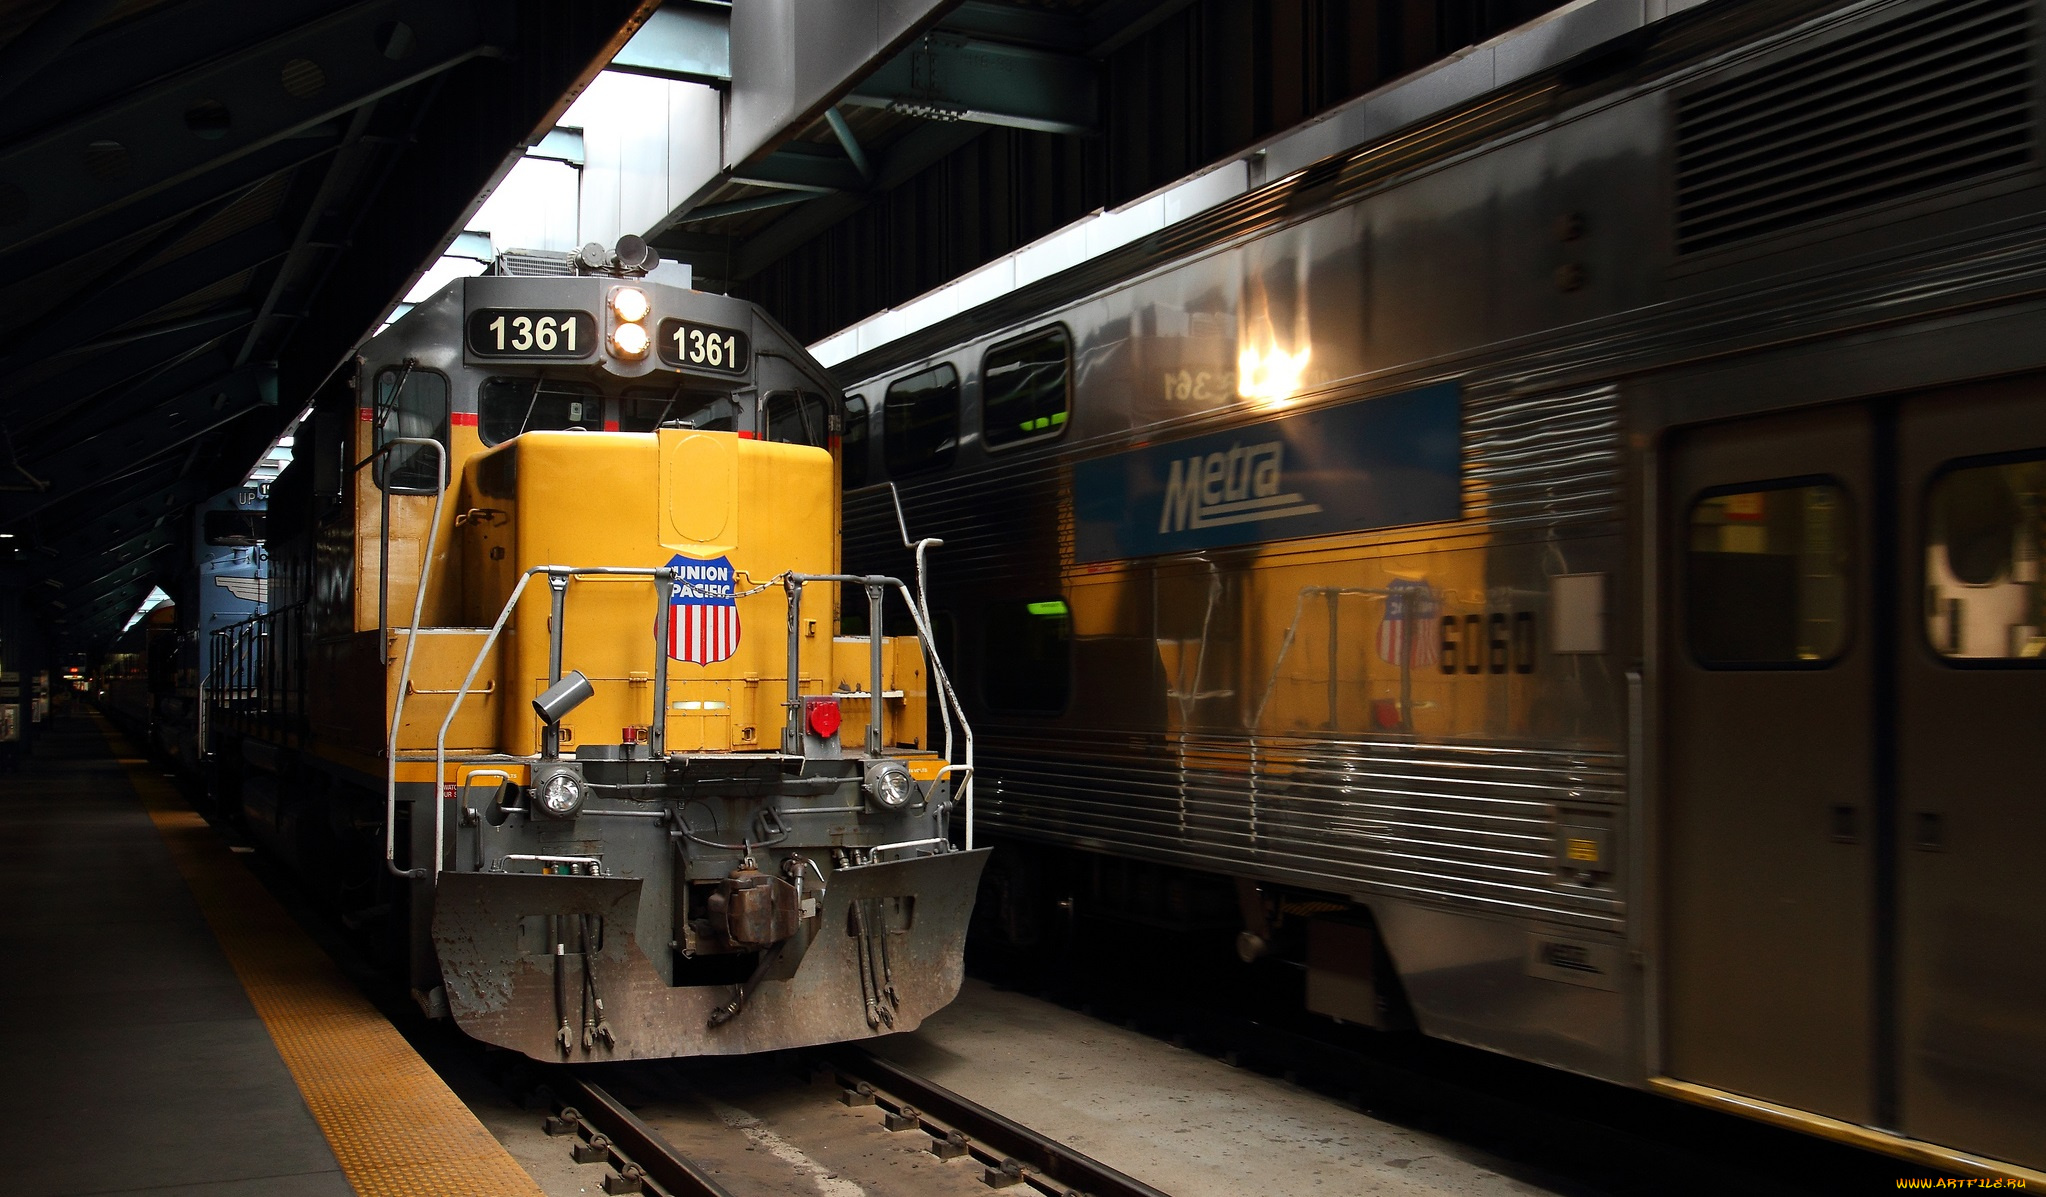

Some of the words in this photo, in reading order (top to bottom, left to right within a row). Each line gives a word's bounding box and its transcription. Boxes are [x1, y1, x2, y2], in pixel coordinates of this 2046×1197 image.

[489, 315, 577, 351] 1361
[672, 326, 736, 369] 1361
[239, 492, 256, 505] UP
[1158, 440, 1288, 534] Metra
[670, 583, 731, 599] PACIFIC
[671, 565, 729, 581] UNION
[1441, 611, 1536, 675] 6060
